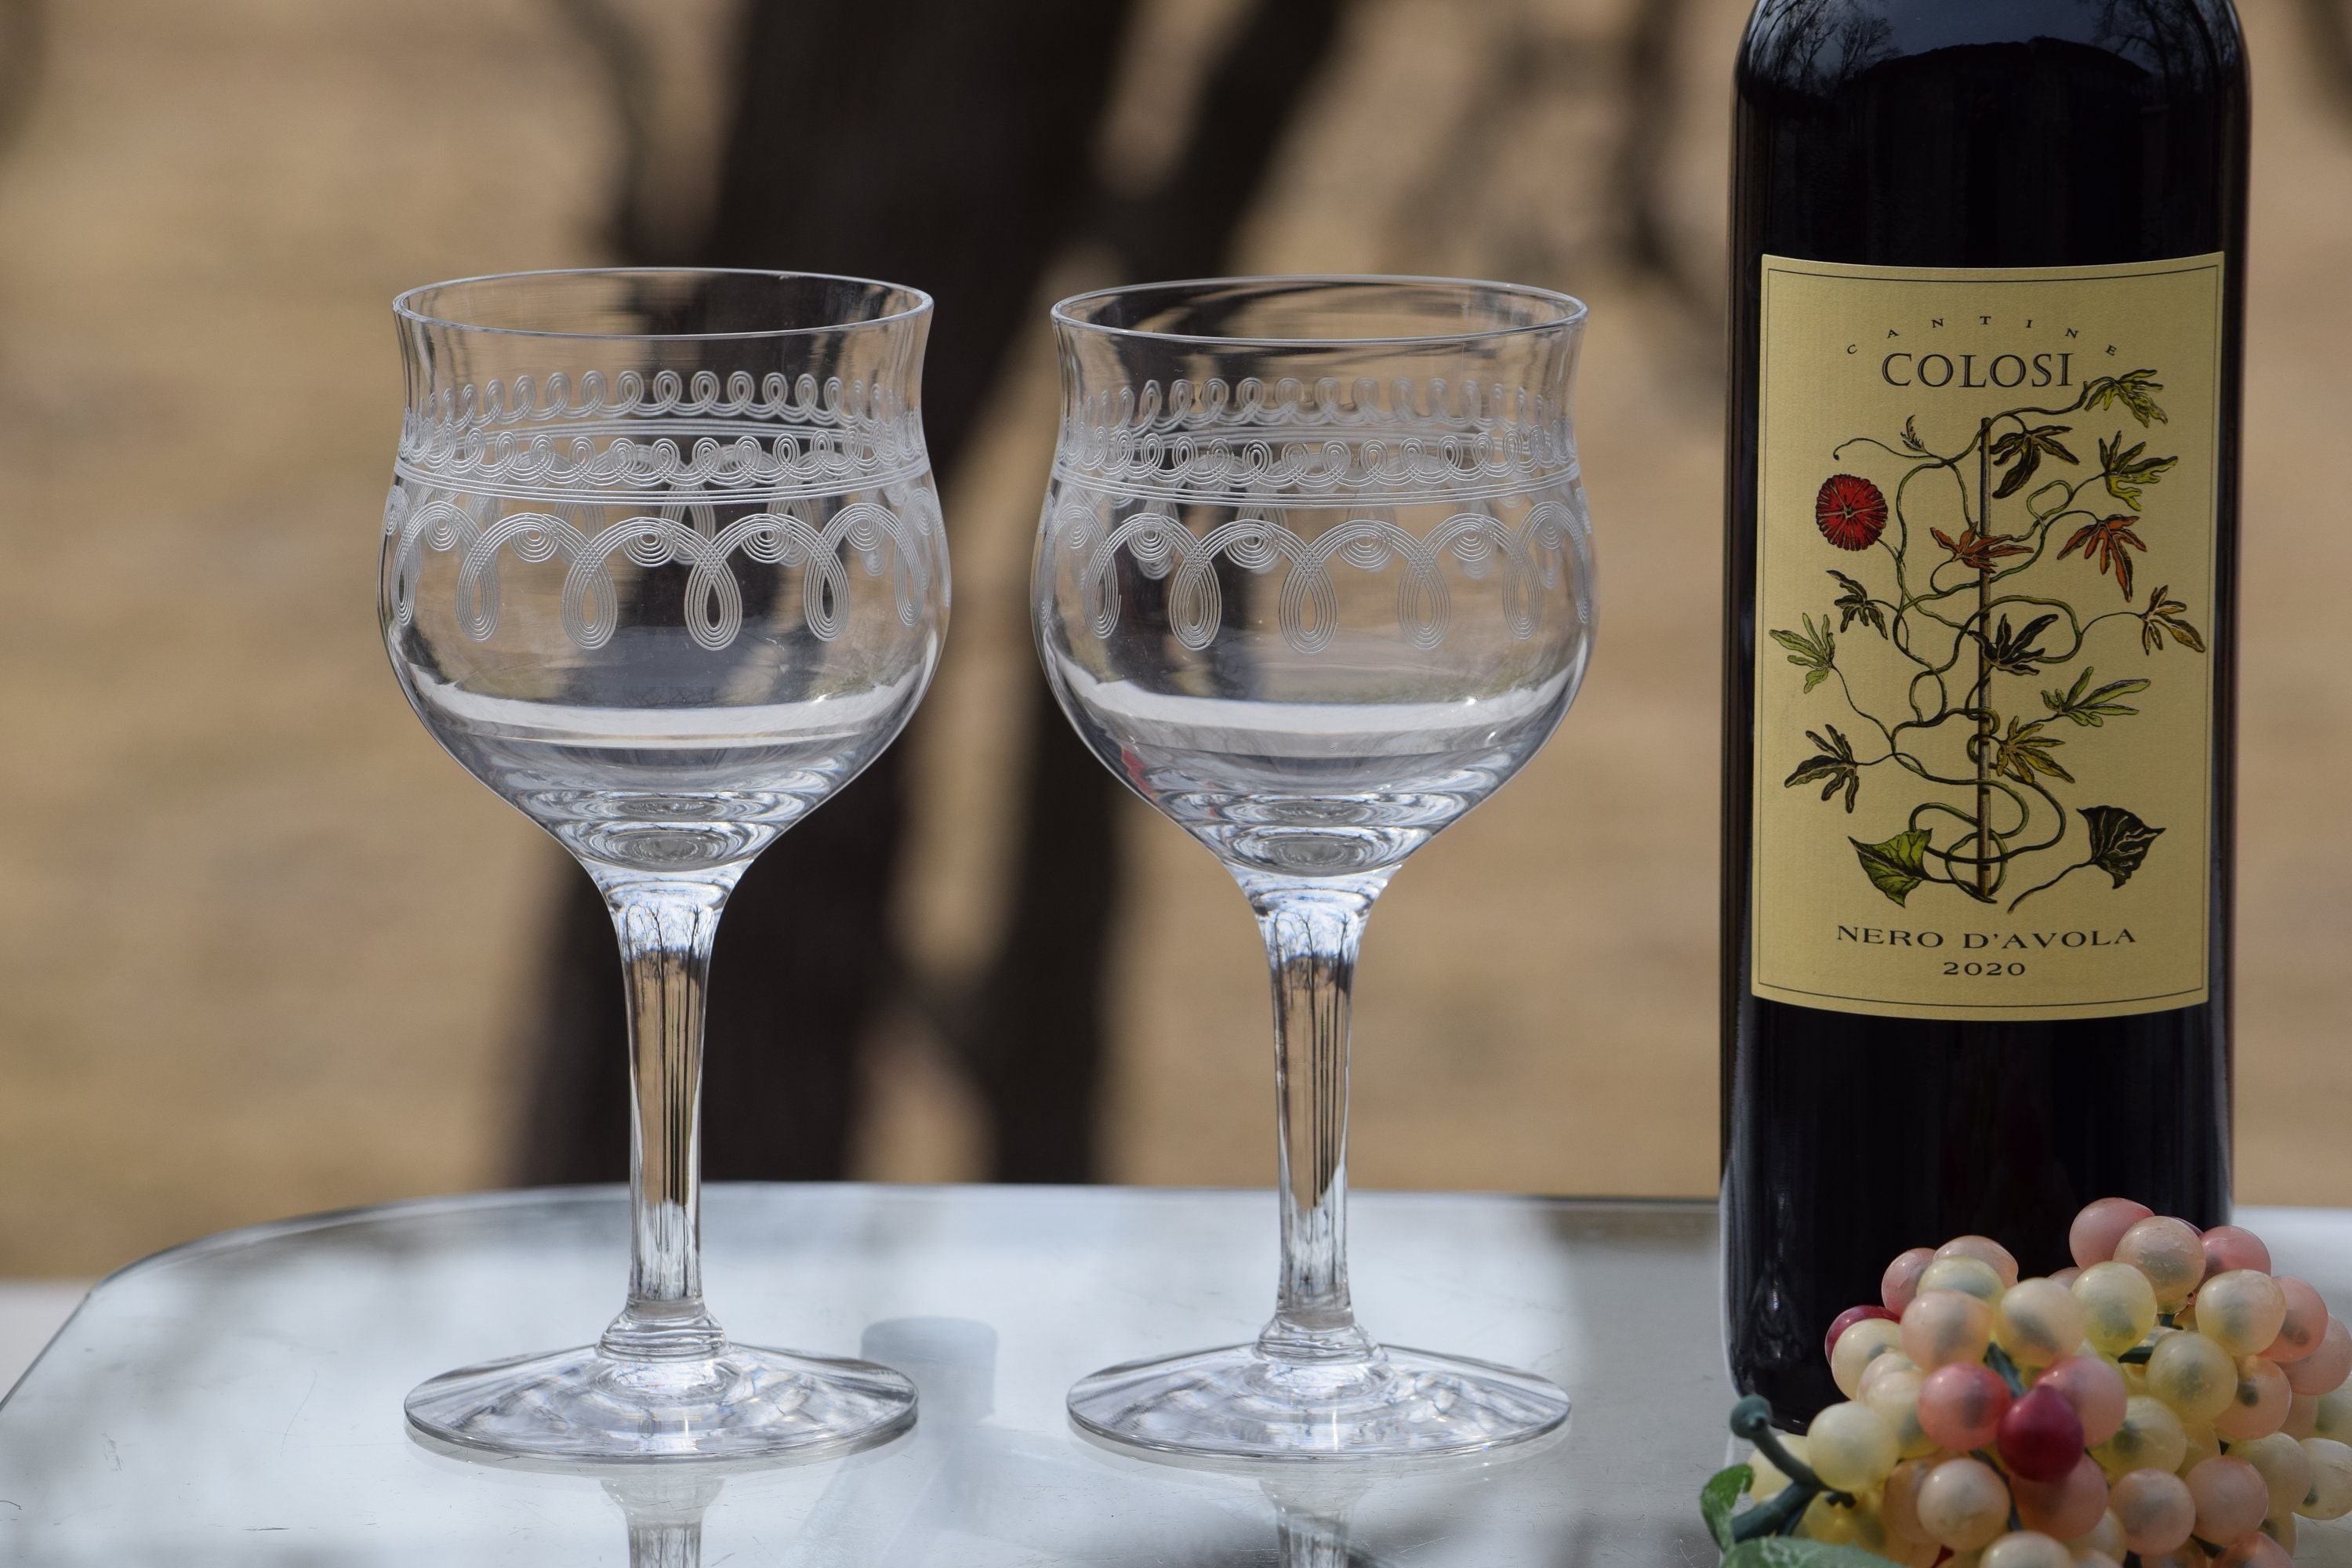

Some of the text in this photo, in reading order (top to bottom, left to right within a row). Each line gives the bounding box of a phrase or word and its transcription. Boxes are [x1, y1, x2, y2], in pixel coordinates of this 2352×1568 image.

[1846, 315, 2118, 356] CANTINE
[1882, 352, 2074, 388] COLOSI
[1837, 925, 2136, 949] NERO D'AVOLA
[1943, 961, 2026, 976] 2020
